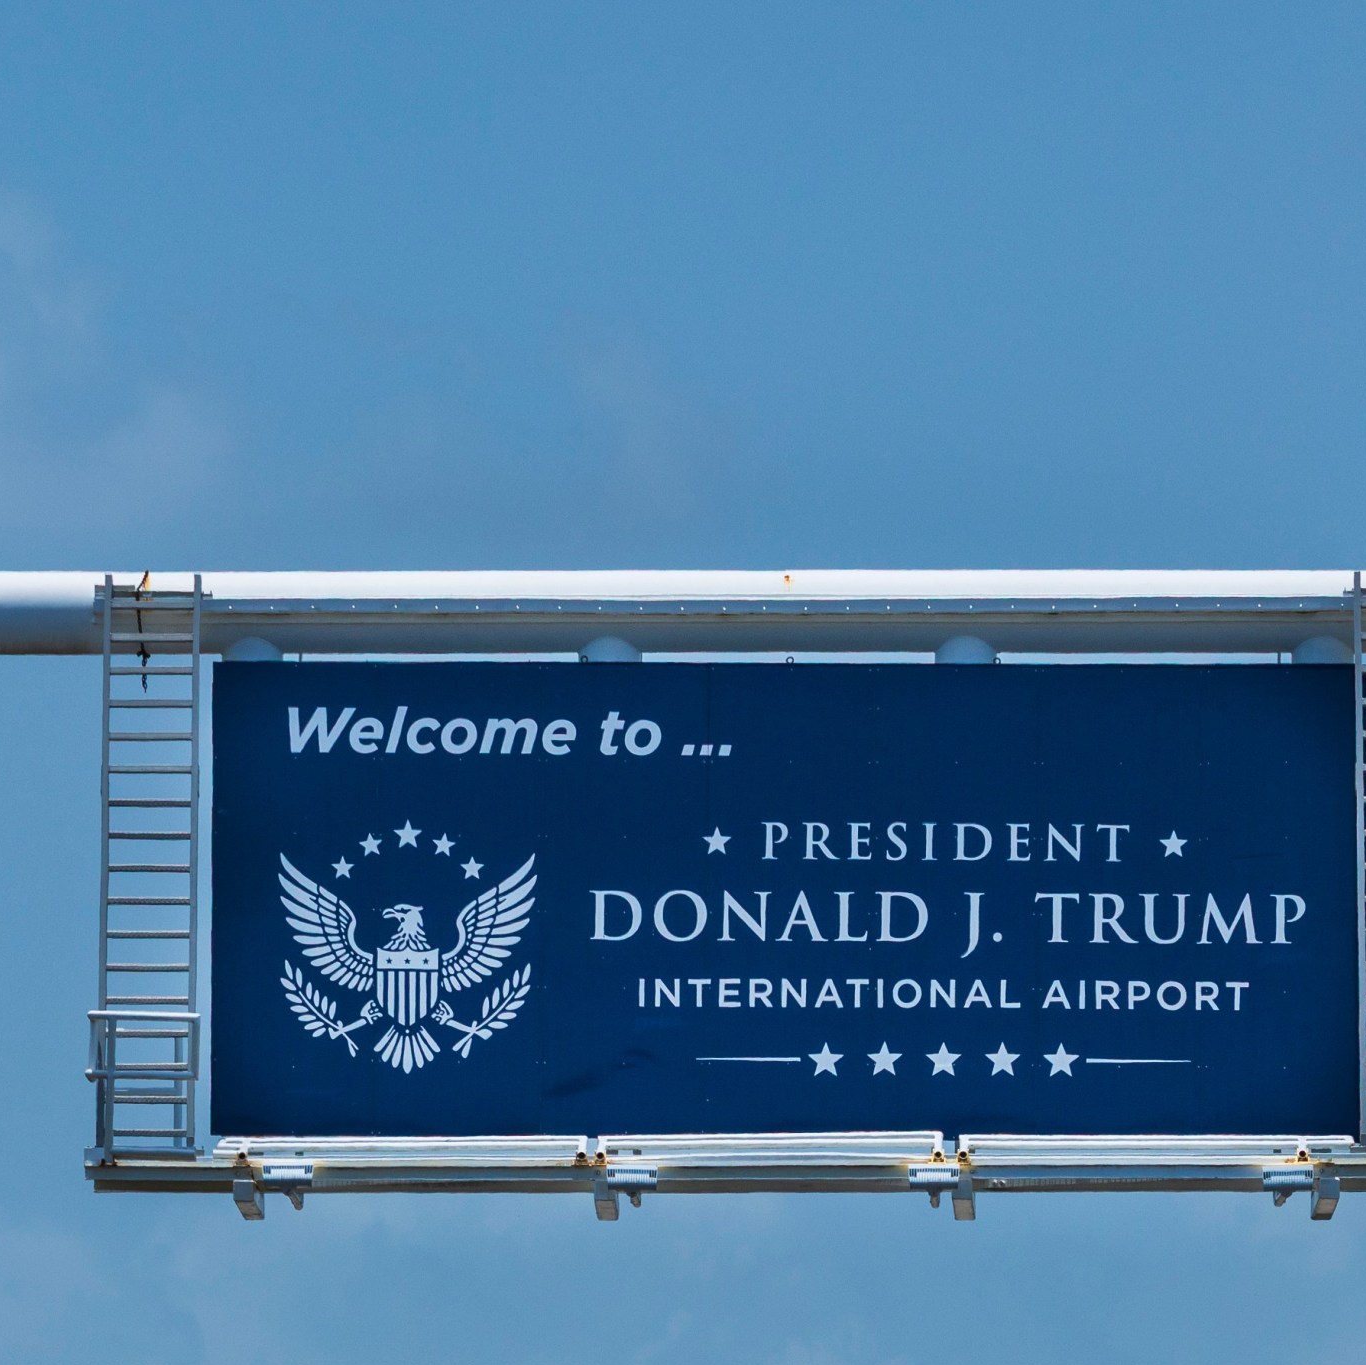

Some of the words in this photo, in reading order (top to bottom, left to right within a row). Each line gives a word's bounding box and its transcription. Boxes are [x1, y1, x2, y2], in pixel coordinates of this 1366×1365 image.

[286, 705, 577, 757] Welcome
[599, 711, 662, 757] to
[760, 821, 1131, 864] PRESIDENT
[588, 888, 930, 944] DONALD
[959, 891, 1004, 959] J.
[1033, 892, 1307, 945] TRUMP
[637, 976, 1022, 1010] INTERNATIONAL
[1041, 979, 1250, 1012] AIRPORT
